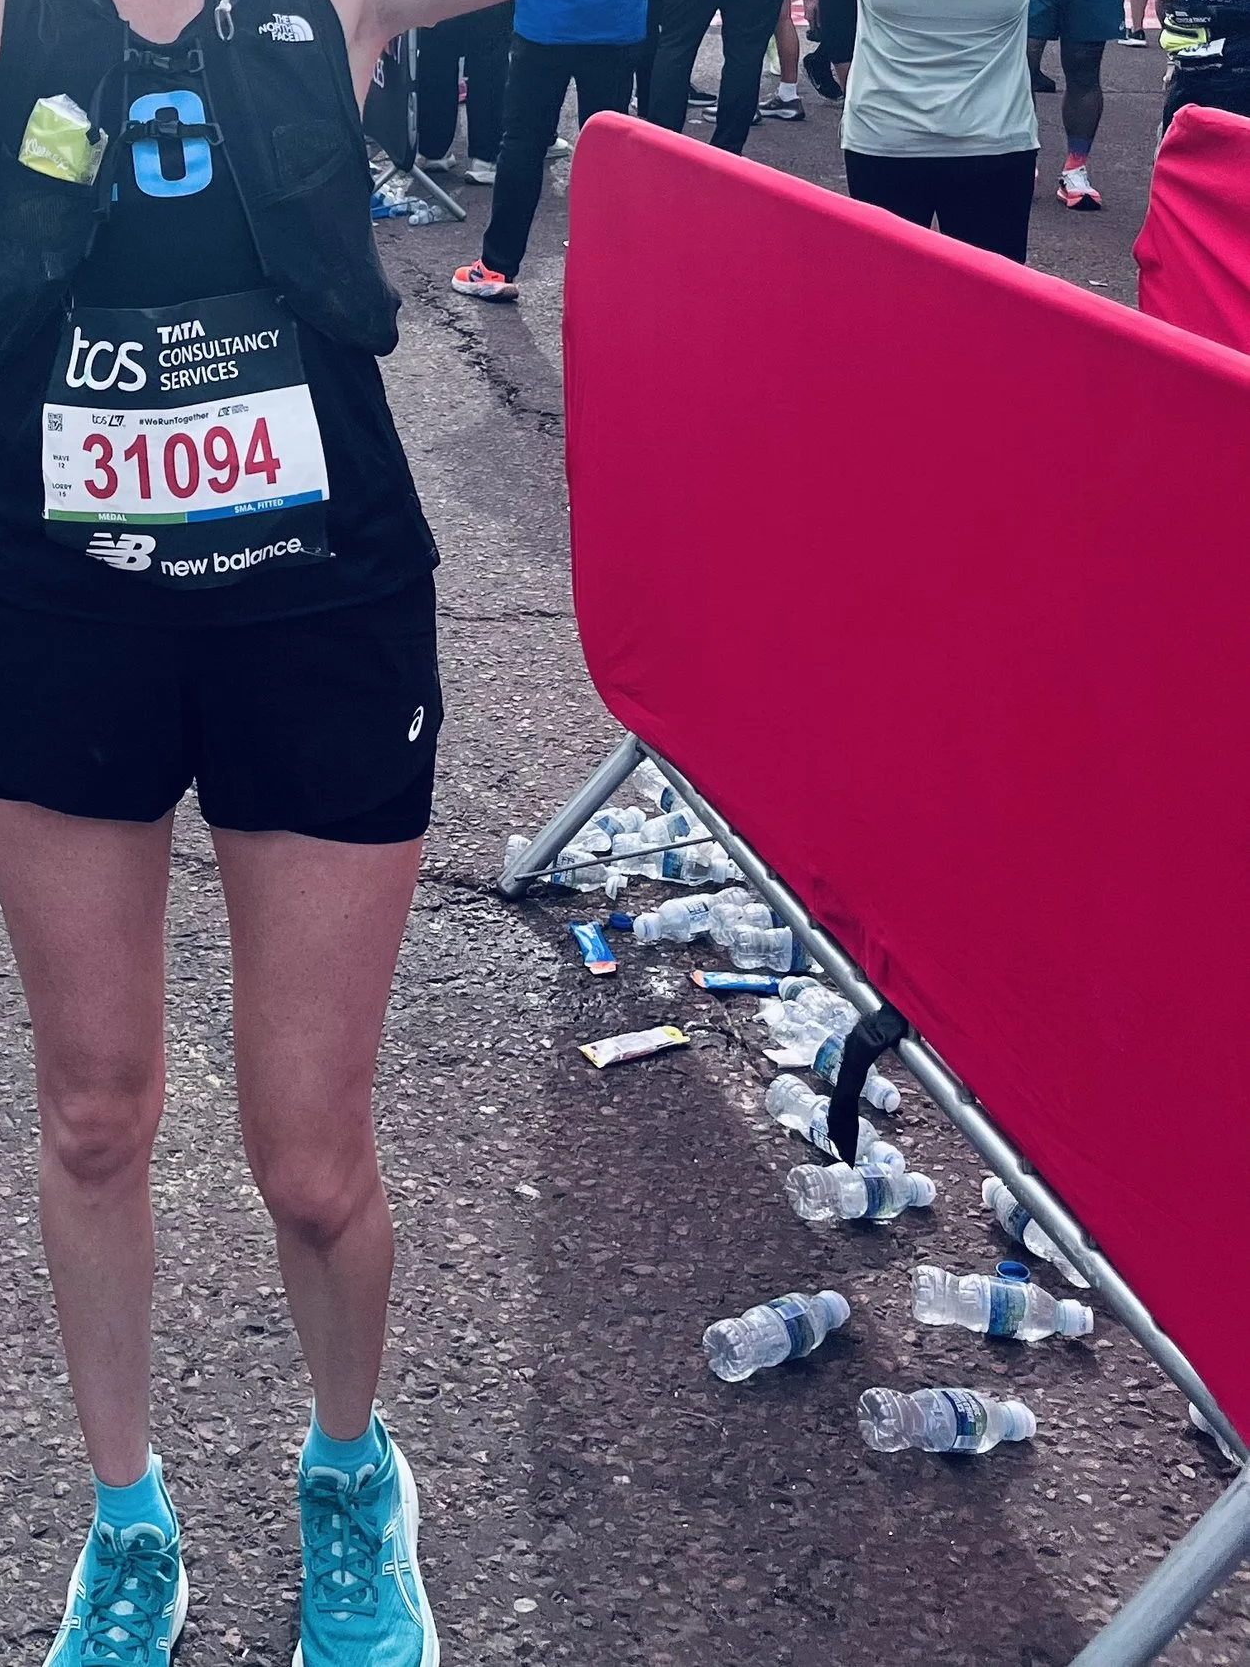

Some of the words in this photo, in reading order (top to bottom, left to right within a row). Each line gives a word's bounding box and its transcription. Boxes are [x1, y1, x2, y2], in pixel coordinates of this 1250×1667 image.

[273, 14, 290, 24] THE
[258, 22, 293, 34] NORTH
[272, 33, 295, 42] FACE
[157, 320, 205, 344] TATA
[158, 330, 279, 368] CONSULTANCY
[66, 326, 146, 392] tcs
[160, 361, 239, 391] SERVICES
[92, 414, 107, 425] tcs
[139, 413, 209, 426] #WeRunTogether
[53, 454, 70, 462] WAVE
[82, 417, 281, 500] 31094
[234, 503, 256, 515] SMA,
[257, 498, 284, 511] FITTED
[98, 513, 127, 522] MEDAL
[85, 532, 156, 571] NB
[161, 558, 208, 577] new
[213, 537, 301, 574] balance
